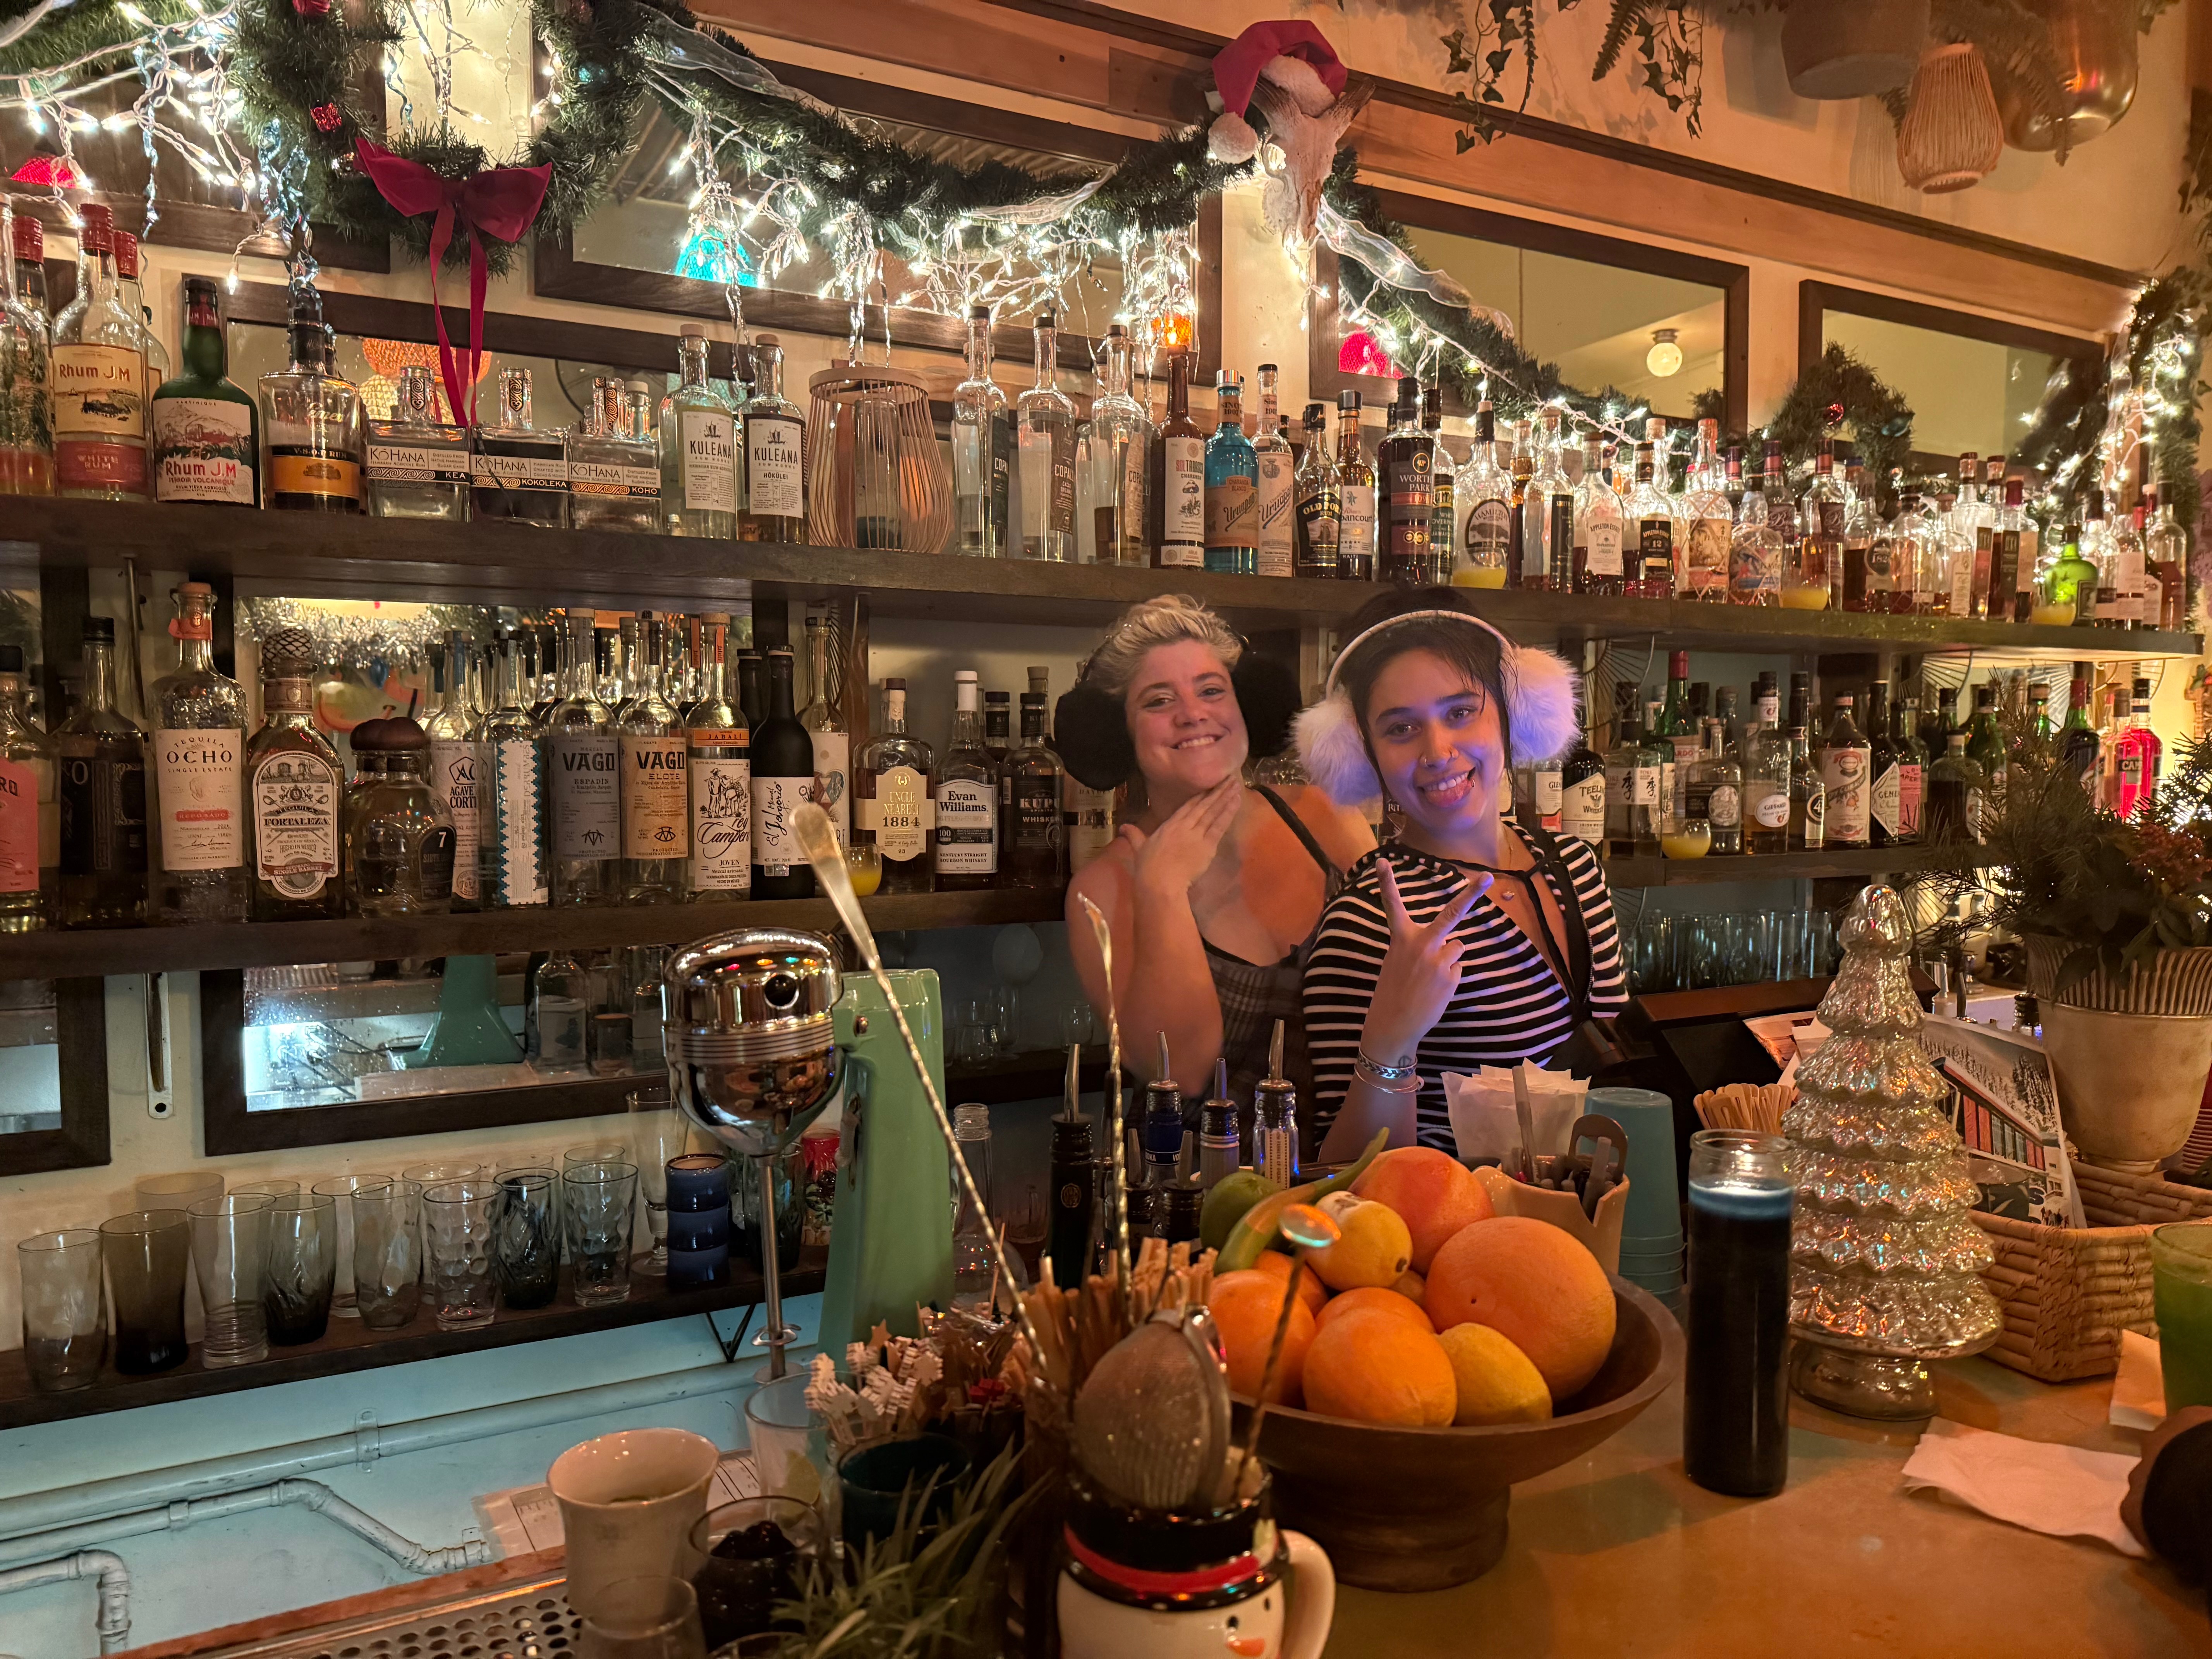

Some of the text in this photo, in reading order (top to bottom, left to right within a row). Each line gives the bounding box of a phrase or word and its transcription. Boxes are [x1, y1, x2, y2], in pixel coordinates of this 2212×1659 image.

[60, 364, 130, 382] Rhum J.M
[329, 451, 347, 459] RUM
[690, 440, 732, 459] KULEANA
[755, 447, 798, 465] KULEANA
[165, 461, 236, 478] Rhum J.M
[194, 477, 234, 486] VOLCANIQUE
[522, 479, 567, 488] KOKOLEKA
[1400, 475, 1432, 483] WORTH
[1409, 484, 1430, 492] PARK
[1303, 502, 1322, 515] OLD
[1590, 523, 1609, 532] APPLETON
[1643, 529, 1659, 538] APPLETON
[1652, 540, 1662, 548] 12
[174, 737, 224, 748] TEQUILA
[167, 750, 232, 764] OCHO
[563, 753, 615, 771] VAGO
[636, 751, 685, 769] VAGO
[0, 776, 18, 797] RO
[450, 786, 474, 796] AGAVE
[890, 792, 915, 803] UNCLE
[948, 791, 977, 800] Evan
[450, 797, 476, 808] CORT
[275, 805, 319, 814] TEQUILA
[884, 804, 919, 815] NEAREST
[264, 817, 330, 826] FORTALEZA
[726, 817, 749, 832] rey
[883, 816, 920, 827] 1884
[438, 831, 447, 848] 7
[763, 832, 780, 846] El
